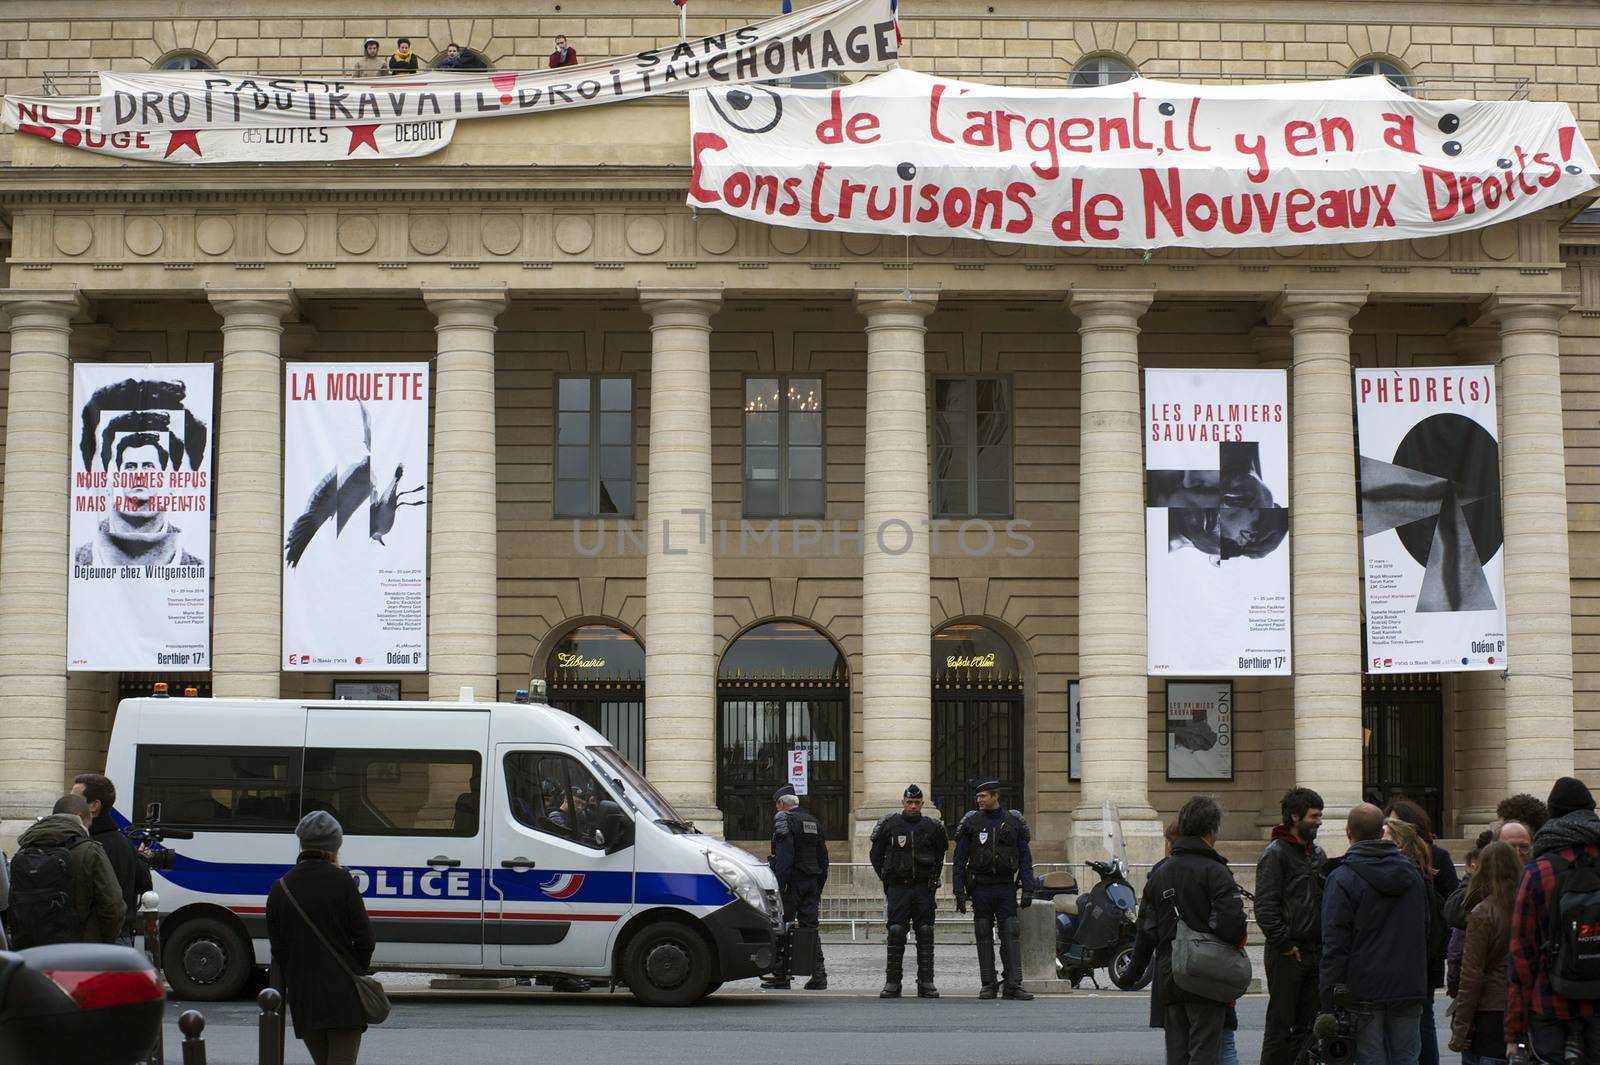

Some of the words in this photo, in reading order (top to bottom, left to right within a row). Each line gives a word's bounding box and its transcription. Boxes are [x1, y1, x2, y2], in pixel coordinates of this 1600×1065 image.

[636, 26, 759, 67] SANS
[114, 90, 241, 125] DROIT
[254, 92, 292, 111] DU
[518, 69, 655, 108] DROIT
[665, 60, 700, 82] AU
[17, 103, 100, 125] NUI
[265, 126, 328, 144] LUTTES
[395, 121, 443, 142] DEBOUT
[815, 90, 881, 144] de
[1235, 134, 1268, 184] y
[1285, 116, 1354, 157] en
[687, 131, 1036, 234] Construisons
[1051, 177, 1124, 243] de
[1138, 166, 1397, 240] Nouveaux
[292, 373, 317, 401] LA
[327, 373, 423, 401] MOUETTE
[1361, 370, 1490, 405] PHÈDRE(s)
[1151, 403, 1182, 421] LES
[1194, 404, 1282, 422] PALMIERS
[1152, 424, 1243, 443] SAUVAGES
[76, 471, 107, 488] NOUS
[113, 472, 164, 488] SOMMES
[169, 471, 207, 488] REPUS
[76, 495, 106, 512] MAIS
[115, 495, 139, 512] PAS
[149, 495, 206, 512] REPENTIS
[120, 565, 141, 579] chez
[145, 564, 205, 580] Wittgenstein
[1472, 640, 1495, 654] Odéon
[158, 652, 190, 664] Berthier
[387, 650, 410, 664] Odéon
[558, 652, 606, 668] Librairie
[1239, 656, 1272, 669] Berthier
[349, 869, 470, 897] OLICE
